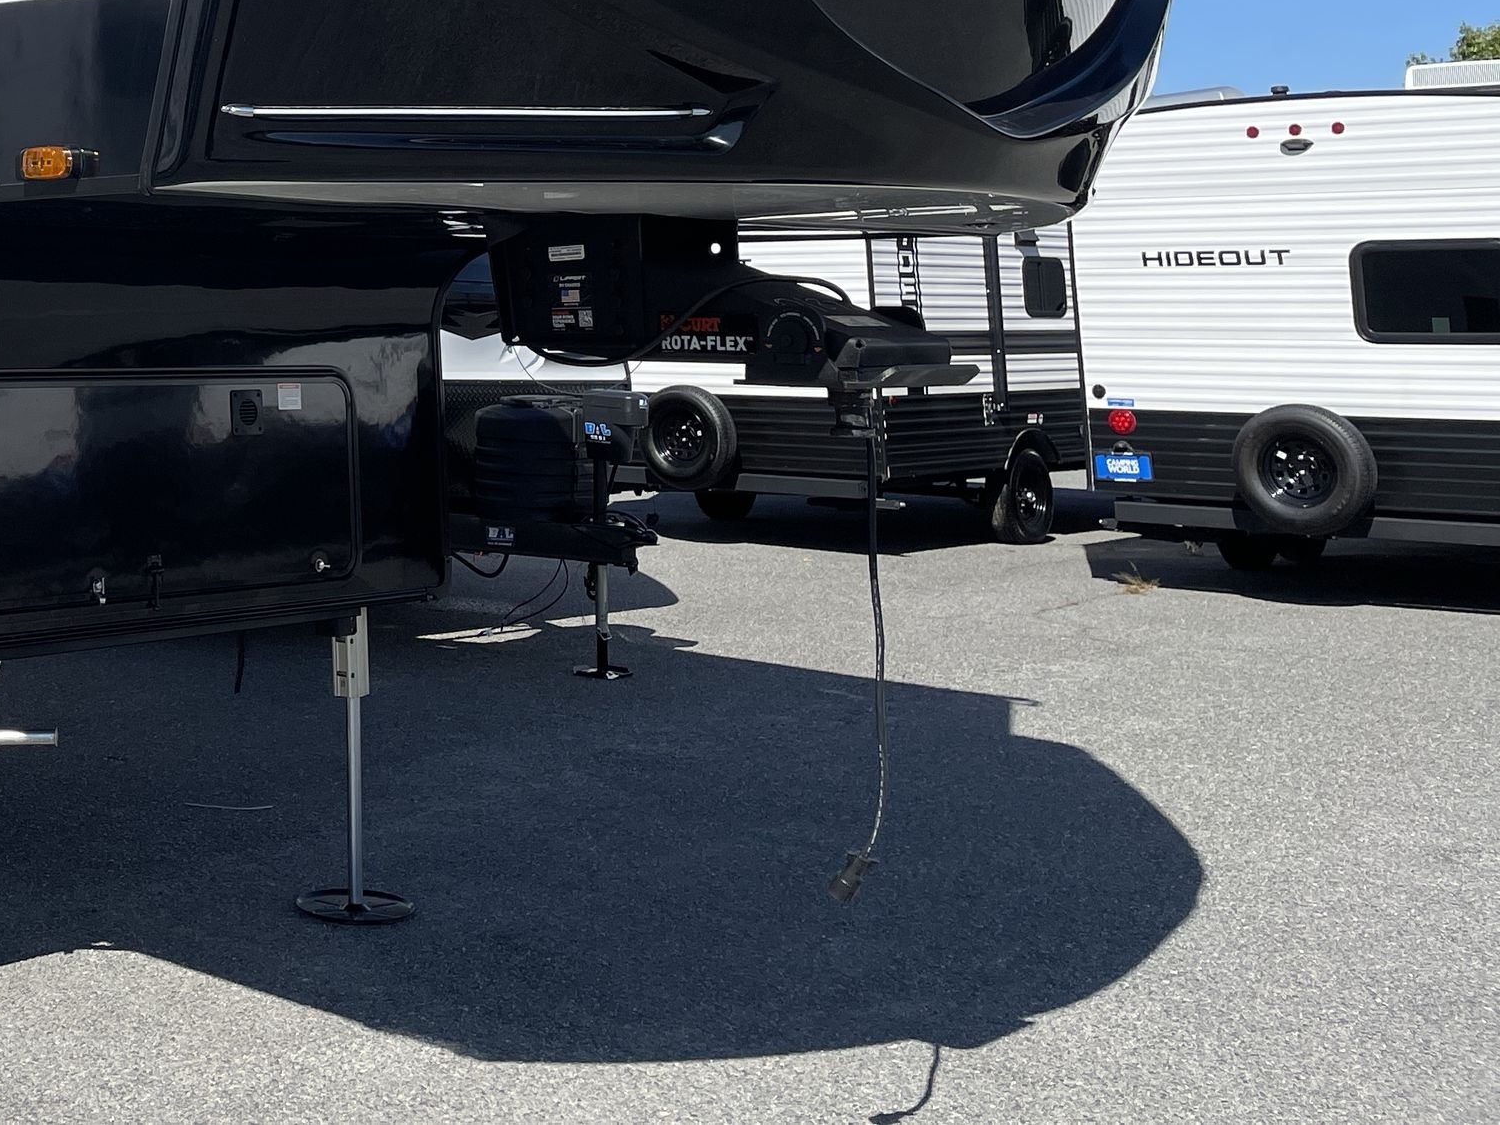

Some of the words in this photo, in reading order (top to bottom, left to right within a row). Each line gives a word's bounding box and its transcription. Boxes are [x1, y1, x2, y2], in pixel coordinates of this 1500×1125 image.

[1141, 249, 1291, 267] HIDEOUT
[1106, 458, 1139, 467] CAMPING
[1107, 464, 1140, 474] WORLD
